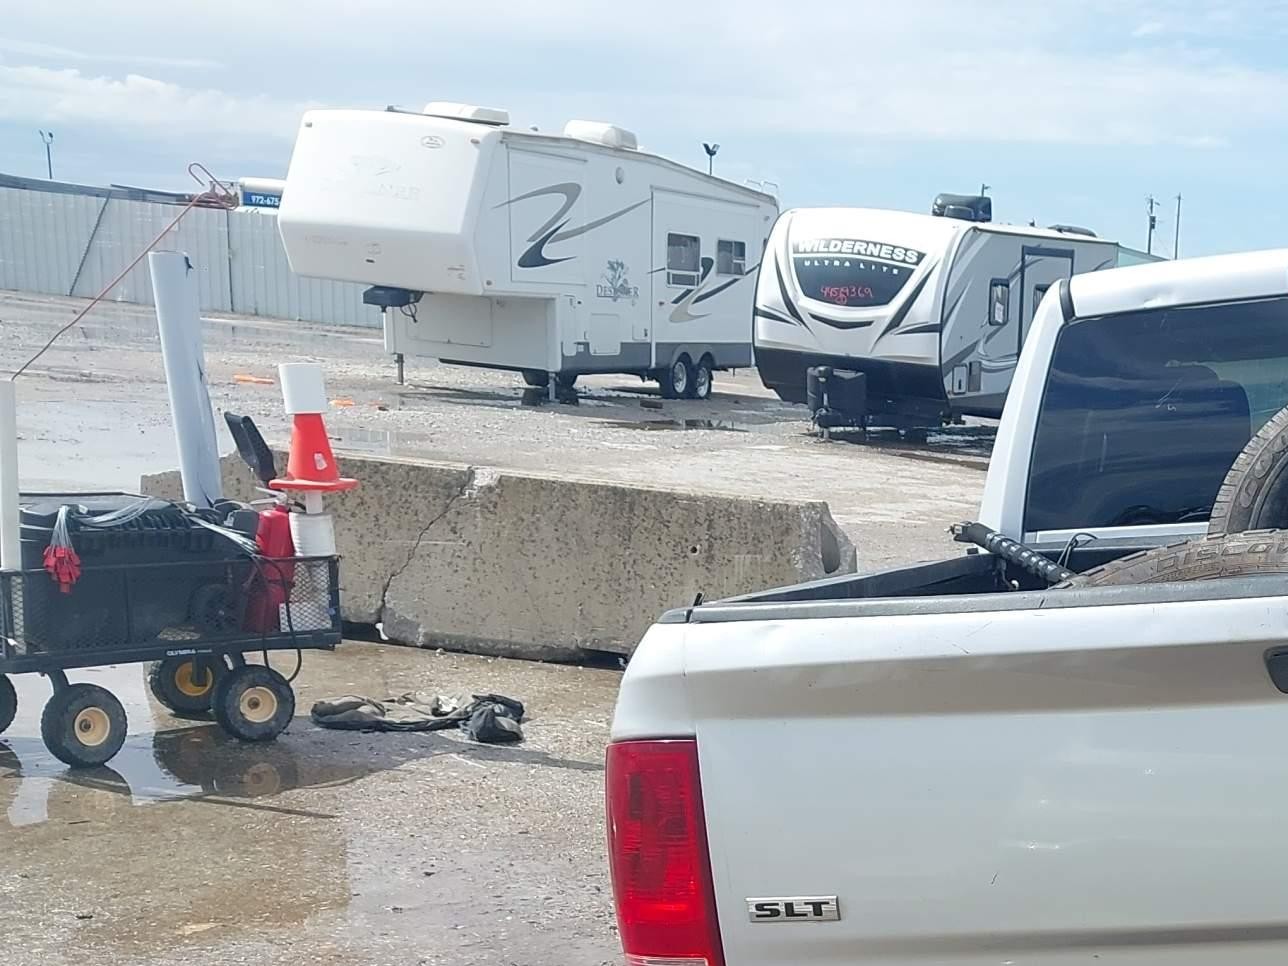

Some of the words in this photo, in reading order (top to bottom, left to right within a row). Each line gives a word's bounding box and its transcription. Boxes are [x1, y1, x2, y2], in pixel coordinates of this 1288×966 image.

[798, 239, 919, 264] WILDERNESS
[804, 259, 850, 268] ULTRA
[859, 262, 899, 275] LITE
[596, 285, 639, 298] DESIER
[755, 902, 830, 918] SLT
